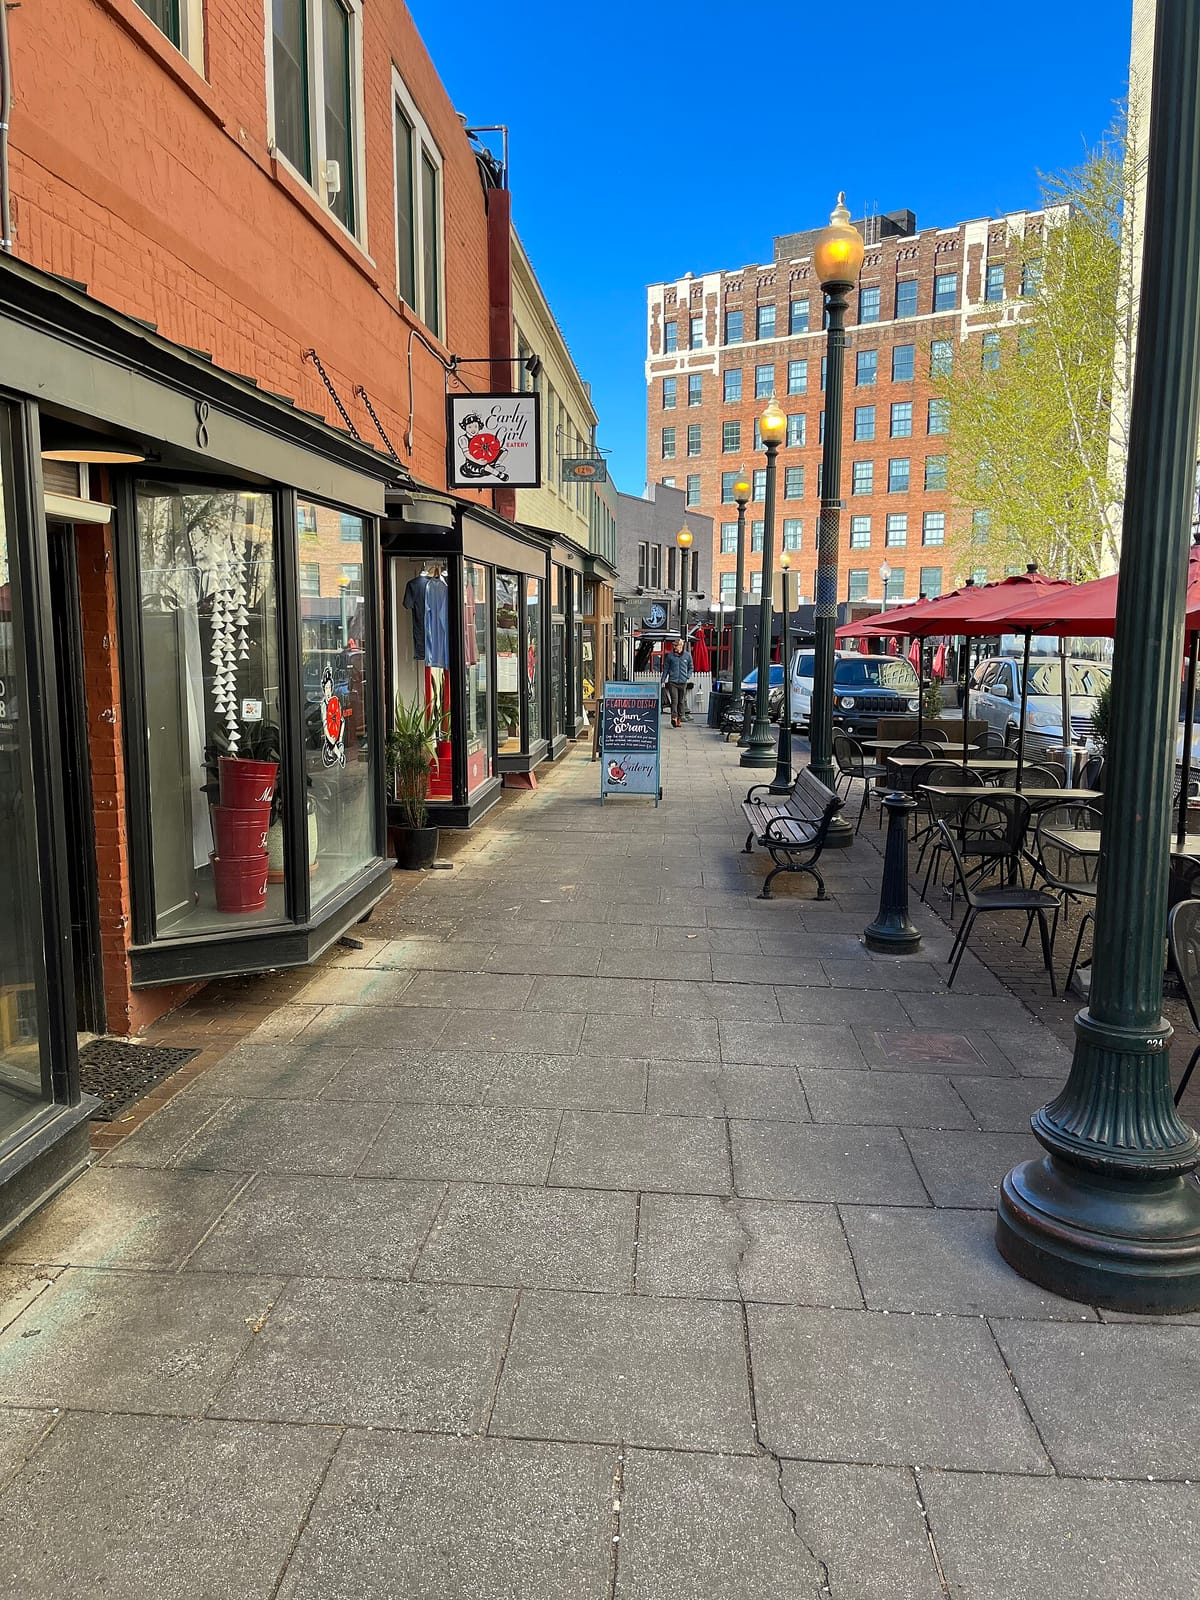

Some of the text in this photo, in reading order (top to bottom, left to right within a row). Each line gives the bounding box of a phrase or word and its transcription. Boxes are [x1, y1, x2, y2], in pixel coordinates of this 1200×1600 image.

[196, 401, 209, 449] 8
[485, 402, 524, 431] Early
[495, 419, 527, 448] Girl
[613, 717, 649, 734] Scram
[617, 708, 641, 723] Yam
